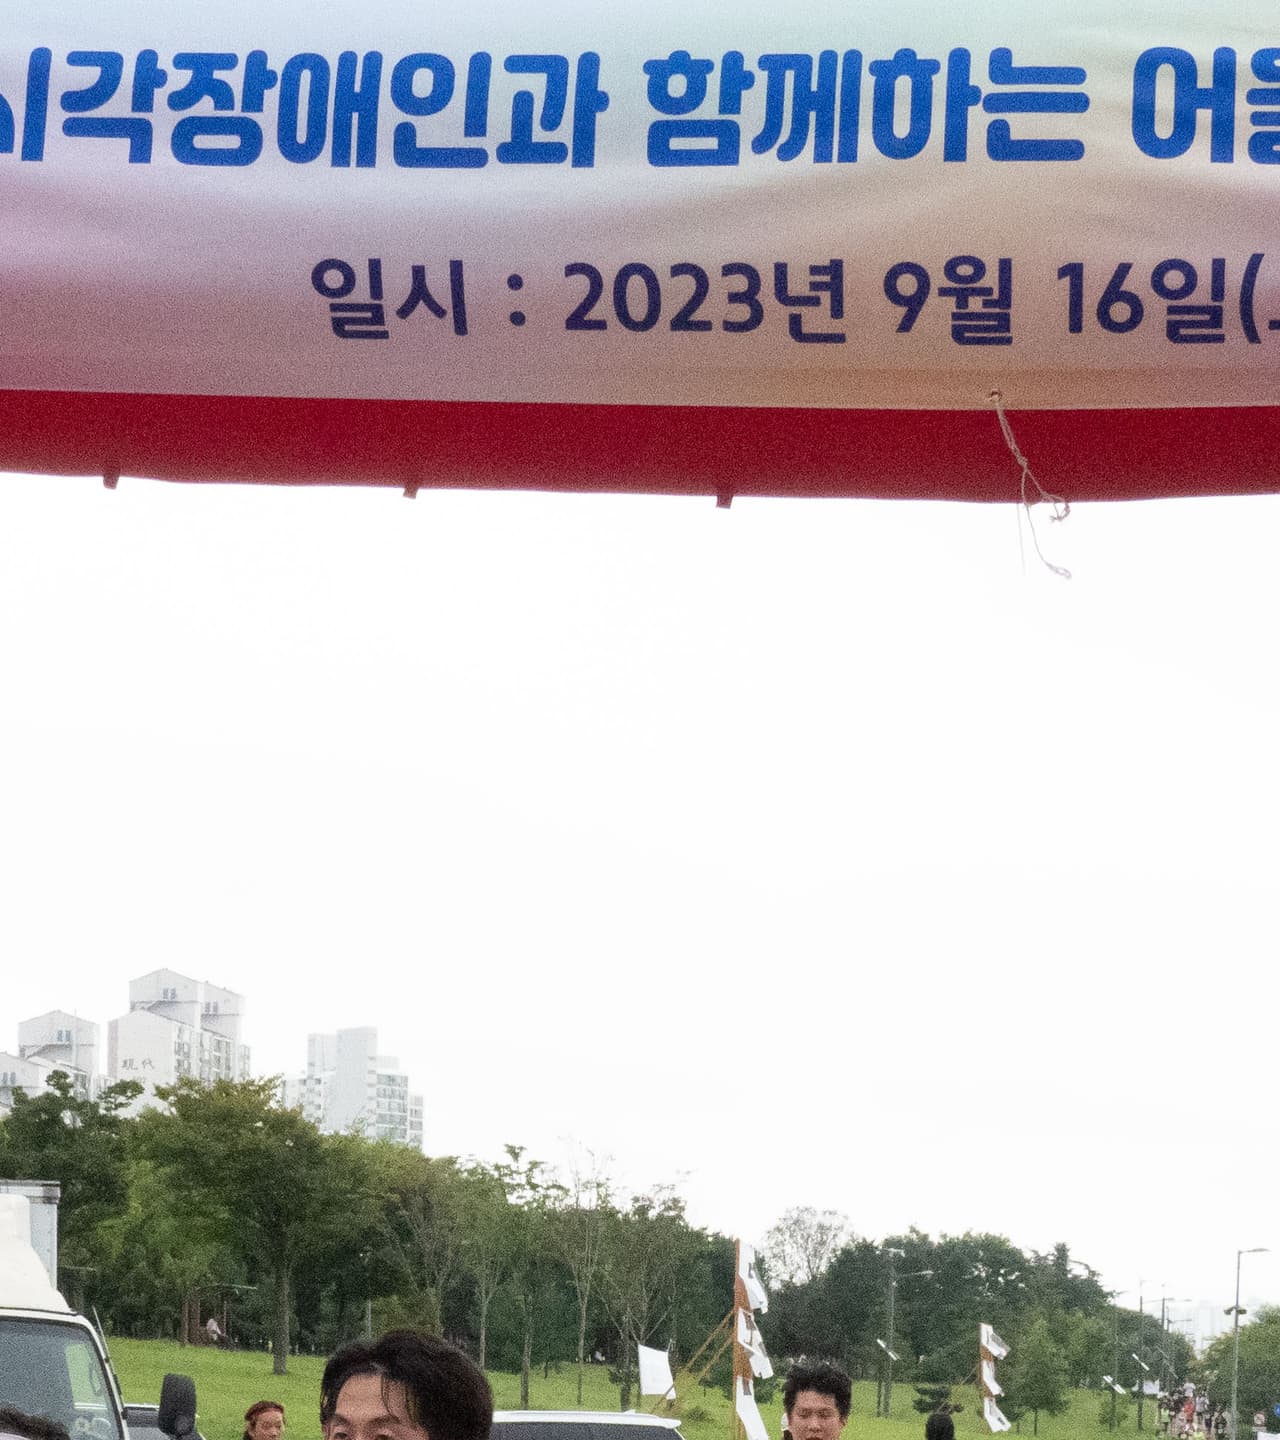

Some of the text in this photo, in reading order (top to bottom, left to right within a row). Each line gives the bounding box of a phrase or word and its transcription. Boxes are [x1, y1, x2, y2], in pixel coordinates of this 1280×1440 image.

[642, 47, 1091, 167] 함께하는
[310, 257, 470, 340] 일시
[562, 257, 847, 345] 2023년
[882, 254, 1014, 347] 9월
